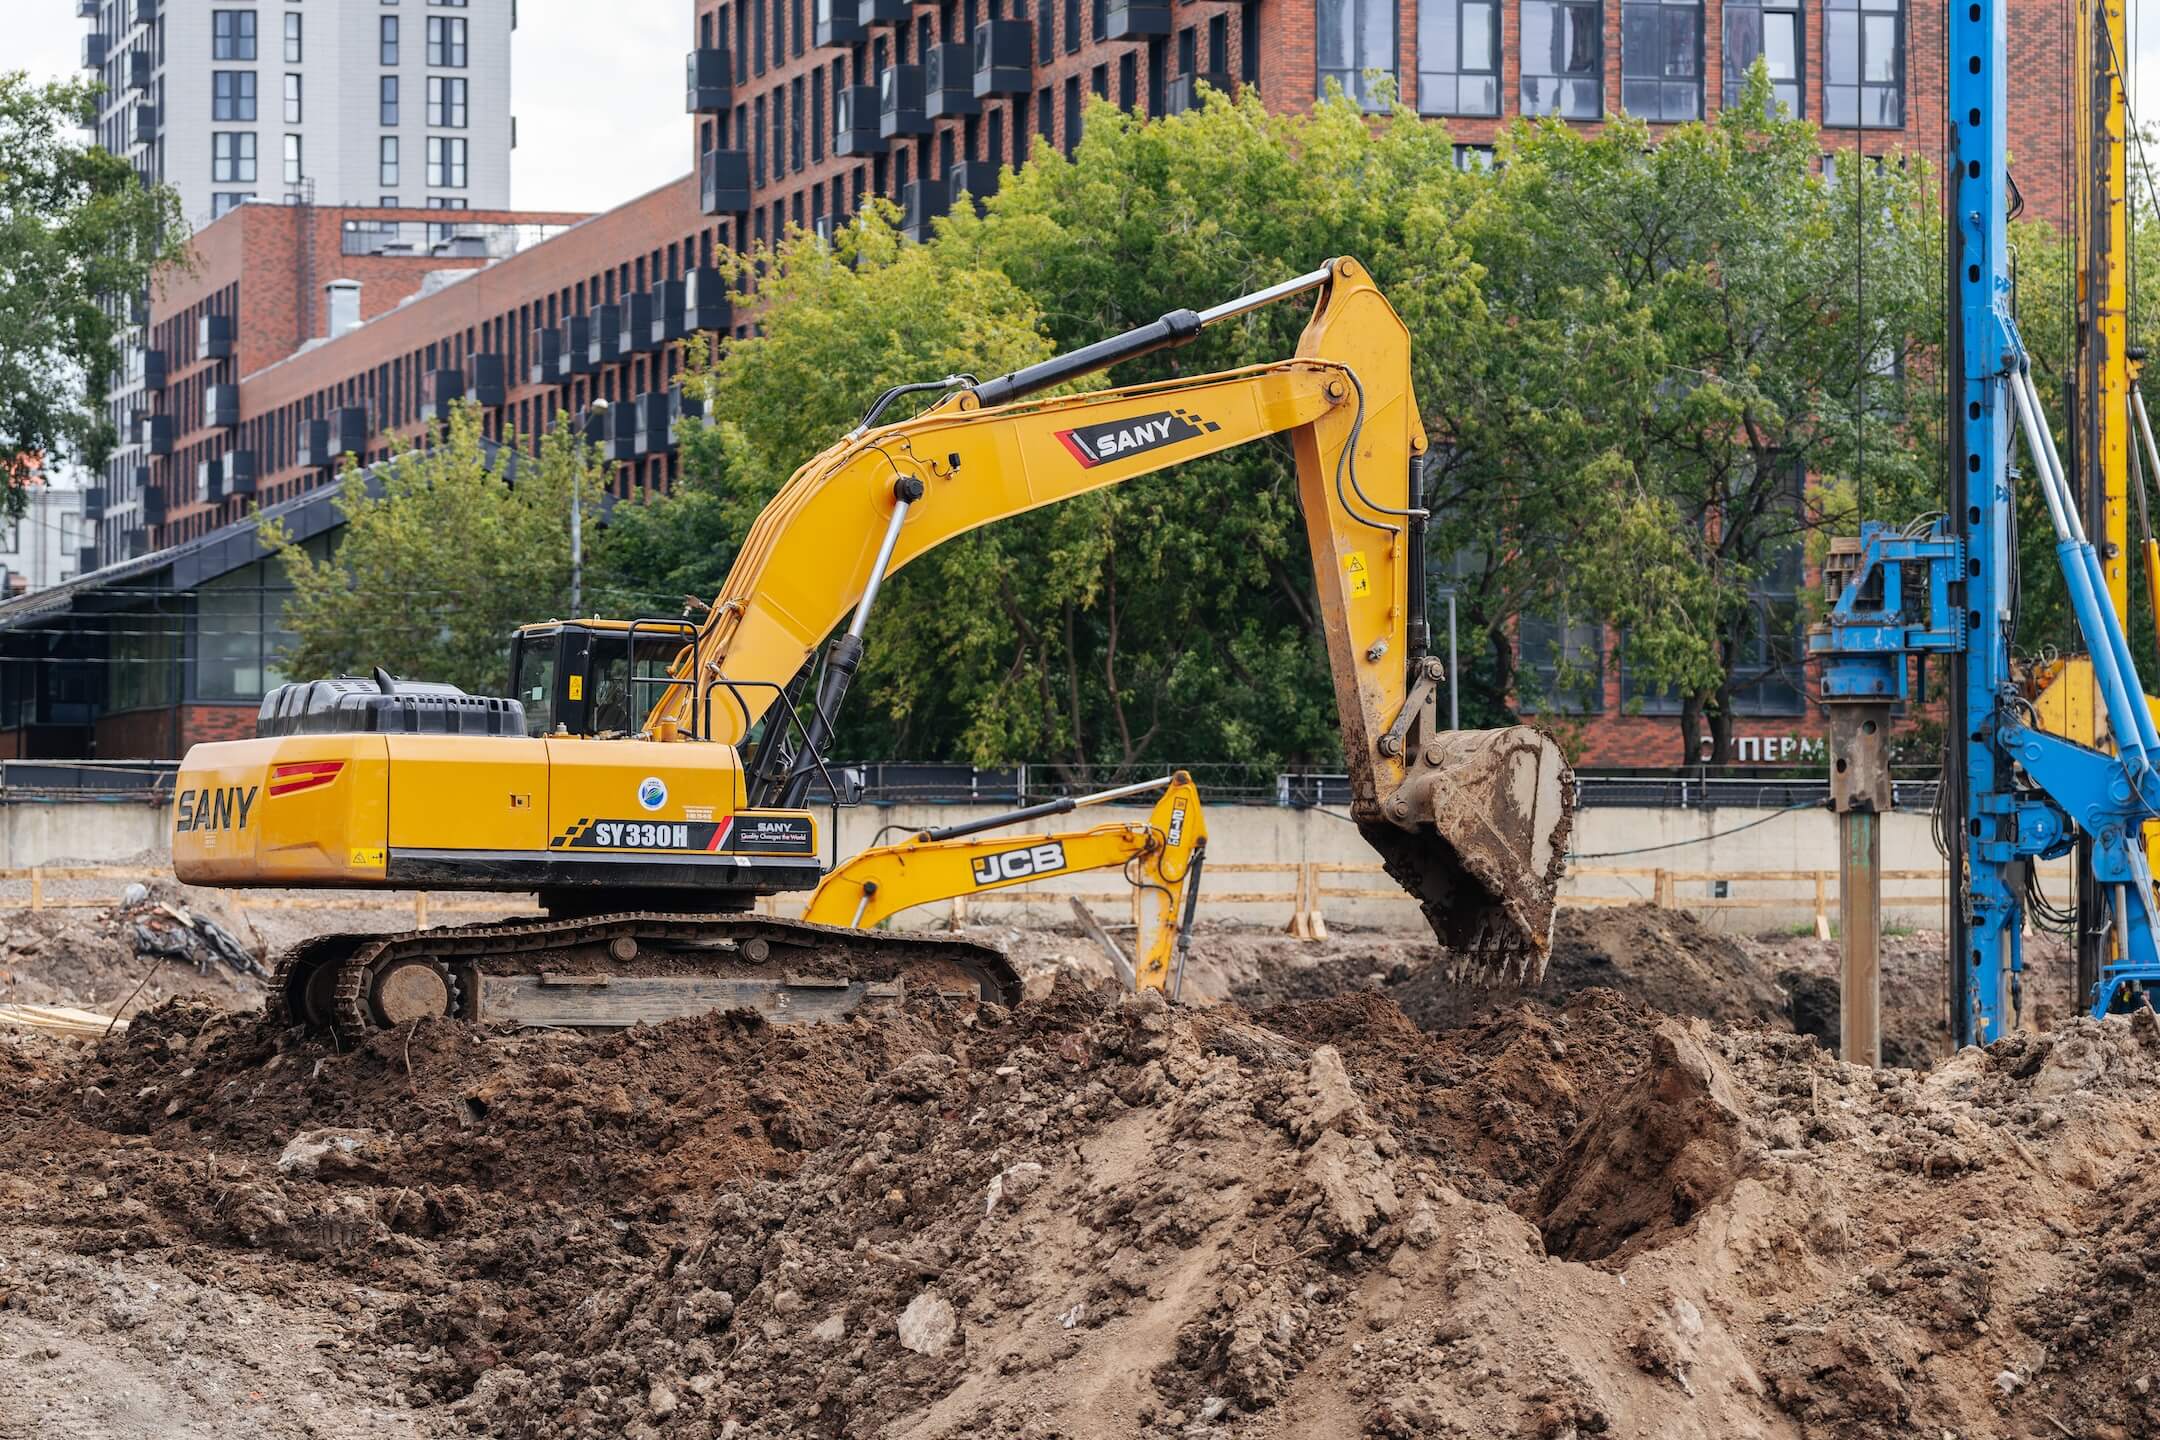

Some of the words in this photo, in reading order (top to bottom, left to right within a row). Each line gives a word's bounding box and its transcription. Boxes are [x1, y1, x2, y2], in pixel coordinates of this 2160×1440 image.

[1097, 416, 1172, 457] SANY
[177, 786, 258, 832] SANY
[596, 823, 688, 847] SY330H
[757, 822, 792, 832] SANY
[760, 833, 781, 842] Changes
[975, 843, 1065, 884] JCB
